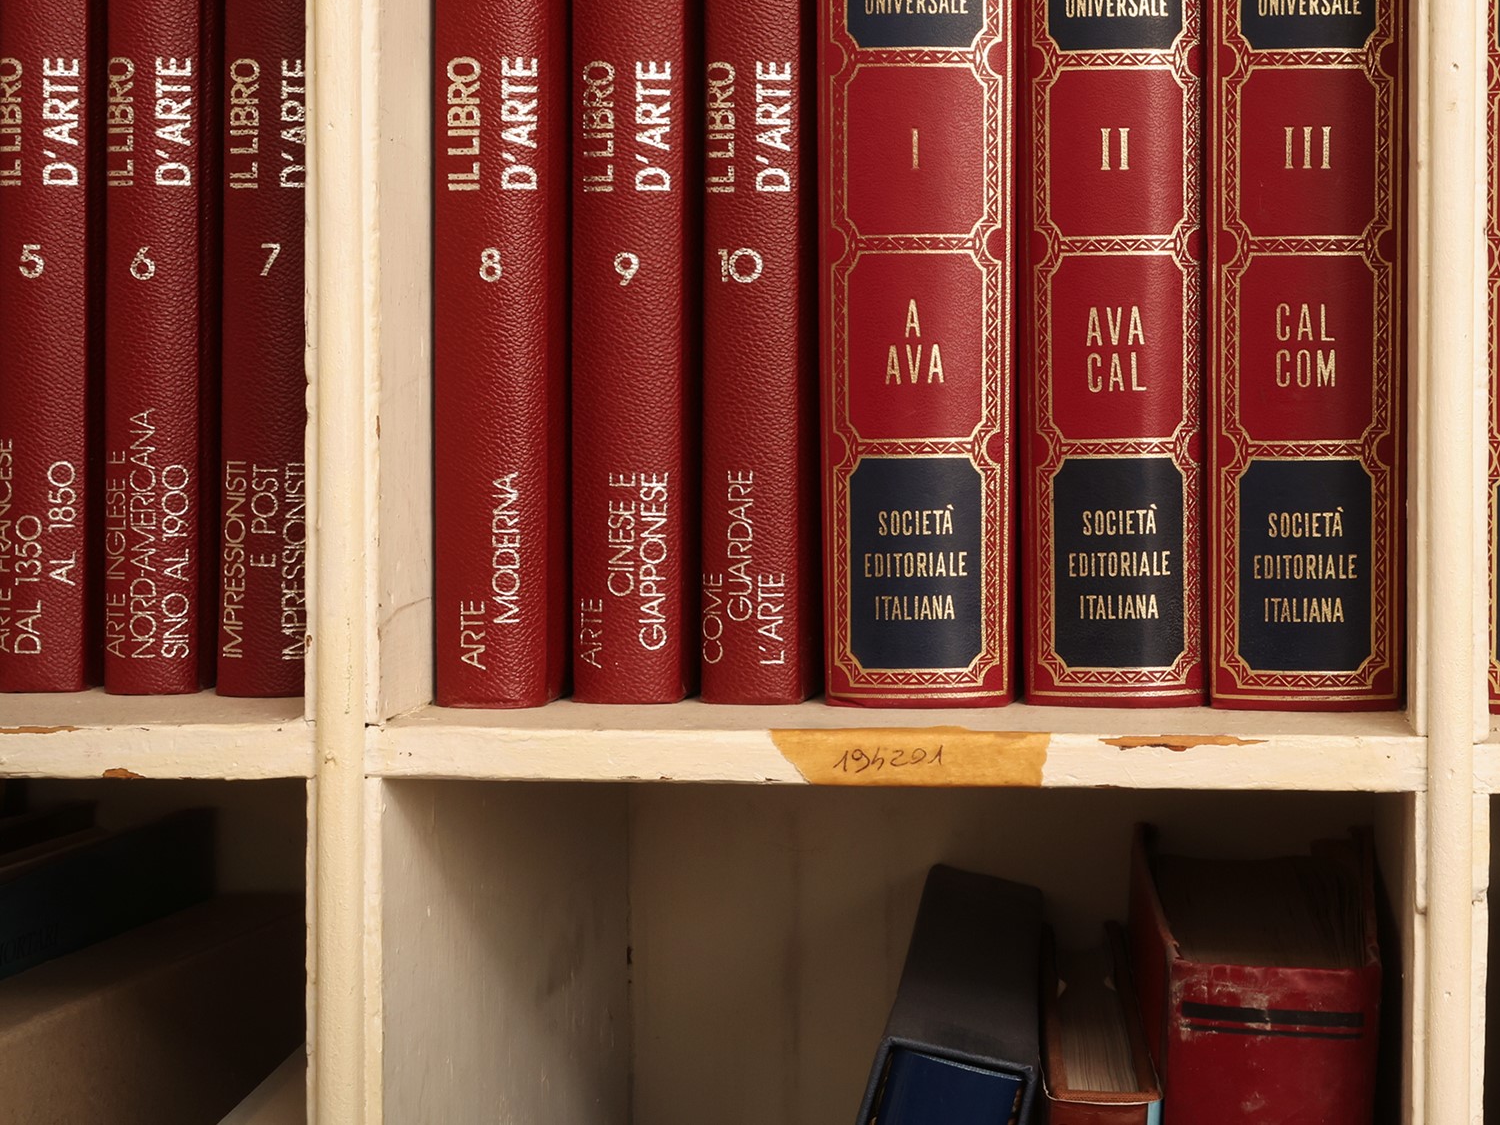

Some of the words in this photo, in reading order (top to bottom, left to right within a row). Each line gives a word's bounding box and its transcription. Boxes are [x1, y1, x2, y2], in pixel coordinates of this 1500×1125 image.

[0, 57, 22, 152] LIBRO
[42, 58, 79, 185] D'ARTE
[108, 57, 135, 151] LIBRO
[155, 57, 191, 186] D'ARTE
[230, 59, 260, 154] LIBRO
[447, 57, 481, 155] LIBRO
[500, 56, 537, 190] D'ARTE
[583, 61, 615, 157] LIBRO
[709, 62, 735, 158] LIBRO
[635, 61, 671, 191] D'ARTE
[756, 61, 792, 192] D'ARTE
[912, 129, 919, 168] I
[1101, 128, 1130, 170] II
[1285, 126, 1331, 169] III
[0, 159, 21, 186] IL
[108, 160, 134, 186] IL
[230, 162, 258, 189] IL
[448, 162, 480, 191] IL
[584, 164, 614, 192] IL
[708, 166, 735, 193] IL
[19, 244, 44, 278] 5
[130, 246, 155, 280] 6
[260, 243, 280, 276] 7
[479, 247, 502, 282] 8
[614, 252, 639, 285] 9
[718, 248, 763, 283] 10
[906, 299, 920, 337] A
[1087, 306, 1145, 346] AVA
[1277, 304, 1335, 341] CAL
[887, 344, 944, 384] AVA
[1088, 352, 1147, 392] CAL
[1277, 350, 1335, 387] COM
[109, 451, 125, 464] E
[47, 461, 77, 532] 1850
[251, 464, 279, 534] POST
[609, 472, 636, 487] E
[161, 465, 189, 541] 1900
[879, 504, 954, 535] SOCIETÀ
[1083, 504, 1157, 535] SOCIETÀ
[1269, 507, 1343, 537] SOCIETÀ
[106, 479, 126, 579] INGLESE
[129, 408, 159, 658] NORD-AMERICANA
[492, 472, 520, 623] MODERNA
[608, 501, 635, 596] CINESE
[727, 470, 754, 621] GUARDARE
[15, 515, 42, 585] 1350
[49, 551, 76, 586] AL
[163, 549, 189, 581] AL
[223, 461, 246, 658] IMPRESSIONISTI
[250, 554, 276, 567] E
[639, 472, 668, 650] GIAPPONESE
[866, 552, 967, 577] EDITORIALE
[1069, 551, 1170, 576] EDITORIALE
[1254, 555, 1357, 579] EDITORIALE
[107, 594, 125, 658] ARTE
[161, 593, 189, 658] SINO
[703, 574, 723, 663] COME
[757, 573, 784, 664] L'ARTE
[876, 595, 955, 620] ITALIANA
[1081, 594, 1159, 619] ITALIANA
[1265, 598, 1344, 622] ITALIANA
[14, 600, 41, 654] DAL
[461, 601, 486, 670] ARTE
[580, 599, 603, 668] ARTE
